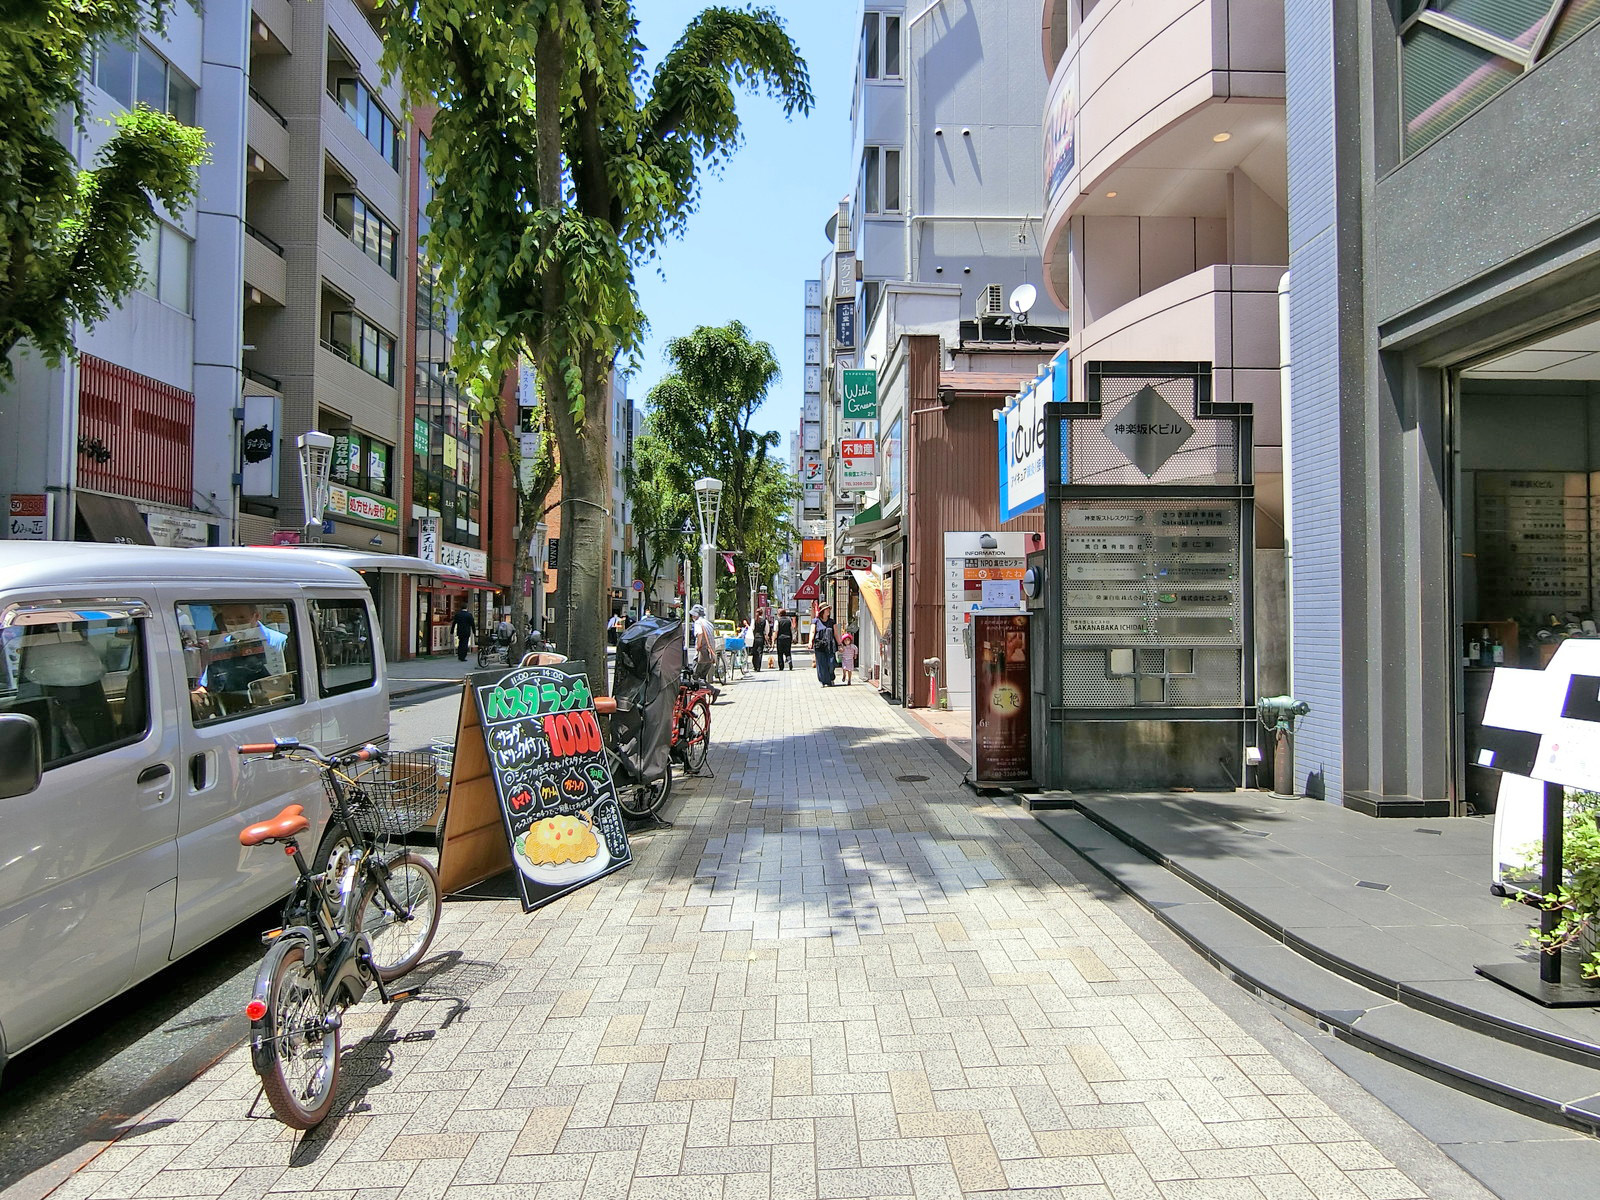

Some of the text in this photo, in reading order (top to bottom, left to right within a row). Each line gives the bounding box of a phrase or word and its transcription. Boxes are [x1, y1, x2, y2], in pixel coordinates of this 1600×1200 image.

[845, 384, 872, 399] With
[848, 398, 877, 413] Green
[1114, 423, 1182, 435] 神楽坂Kビル
[843, 444, 873, 455] 不動産
[349, 495, 386, 519] 処方せん受付
[386, 506, 397, 521] 2F
[849, 559, 868, 568] たばこ
[511, 671, 529, 684] 11:00
[542, 669, 564, 681] 14:00
[488, 679, 590, 719] パスタランチ
[496, 722, 522, 746] サラダ
[589, 767, 605, 780] 和風
[541, 786, 558, 800] クリーム
[564, 779, 585, 792] ガーリック
[511, 790, 532, 810] トマト
